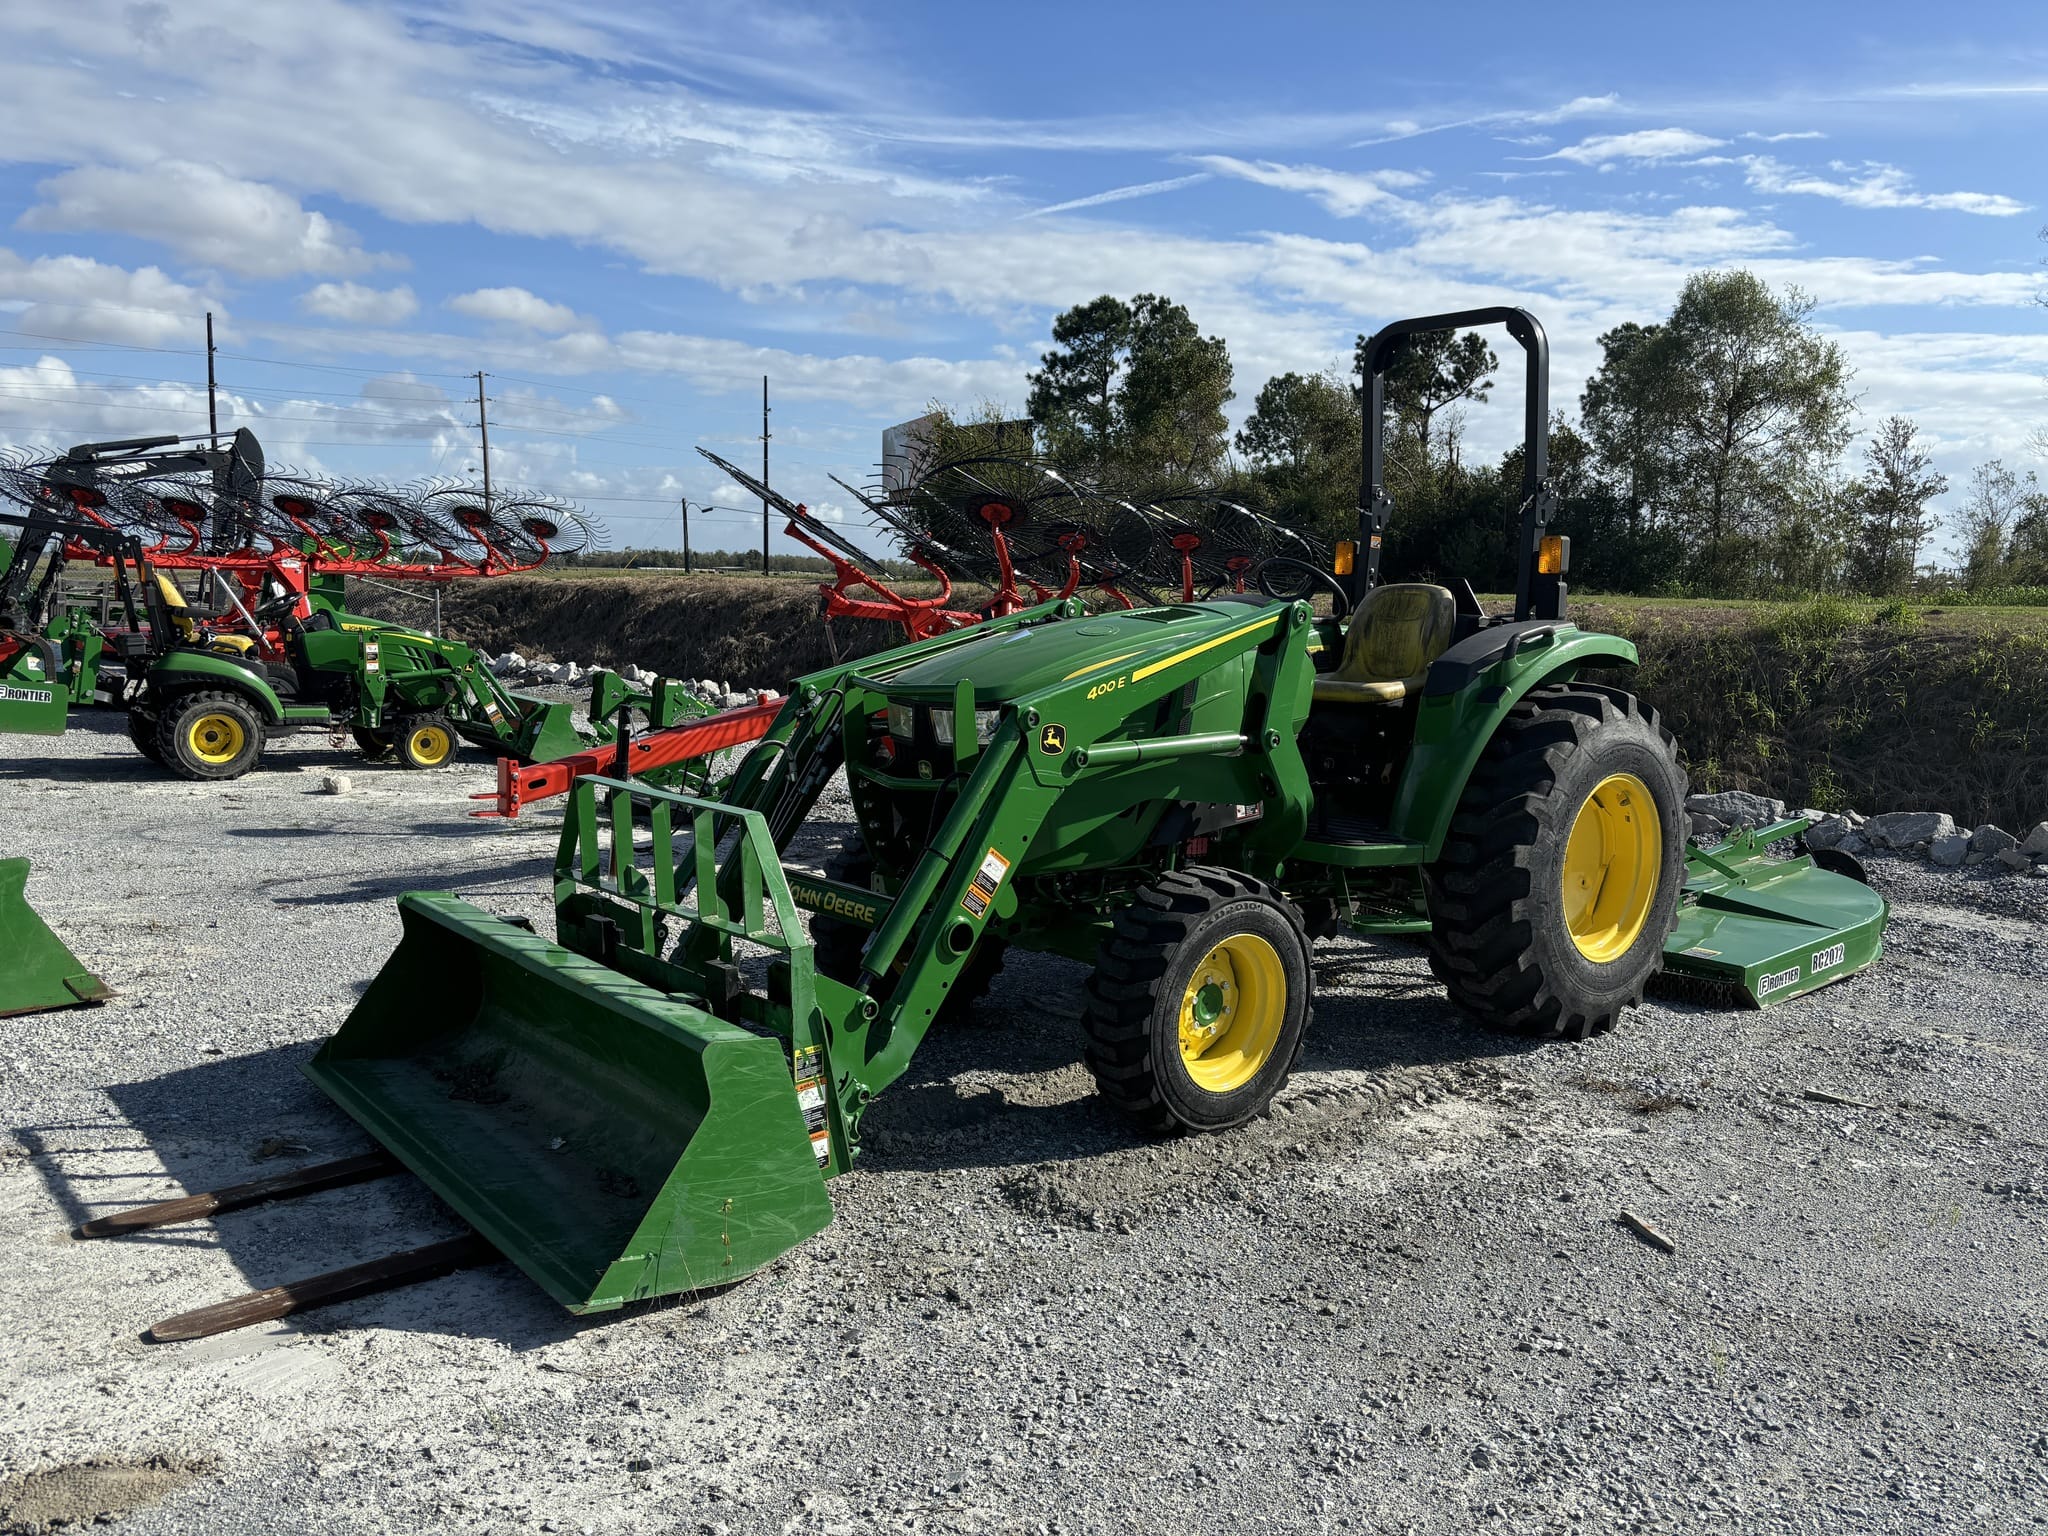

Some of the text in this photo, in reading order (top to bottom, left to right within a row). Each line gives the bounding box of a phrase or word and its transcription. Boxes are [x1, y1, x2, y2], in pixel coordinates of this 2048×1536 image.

[1086, 676, 1127, 700] 400 E
[823, 891, 876, 924] DEERE
[1812, 943, 1844, 973] RC2072
[1759, 967, 1799, 996] FRONTIER
